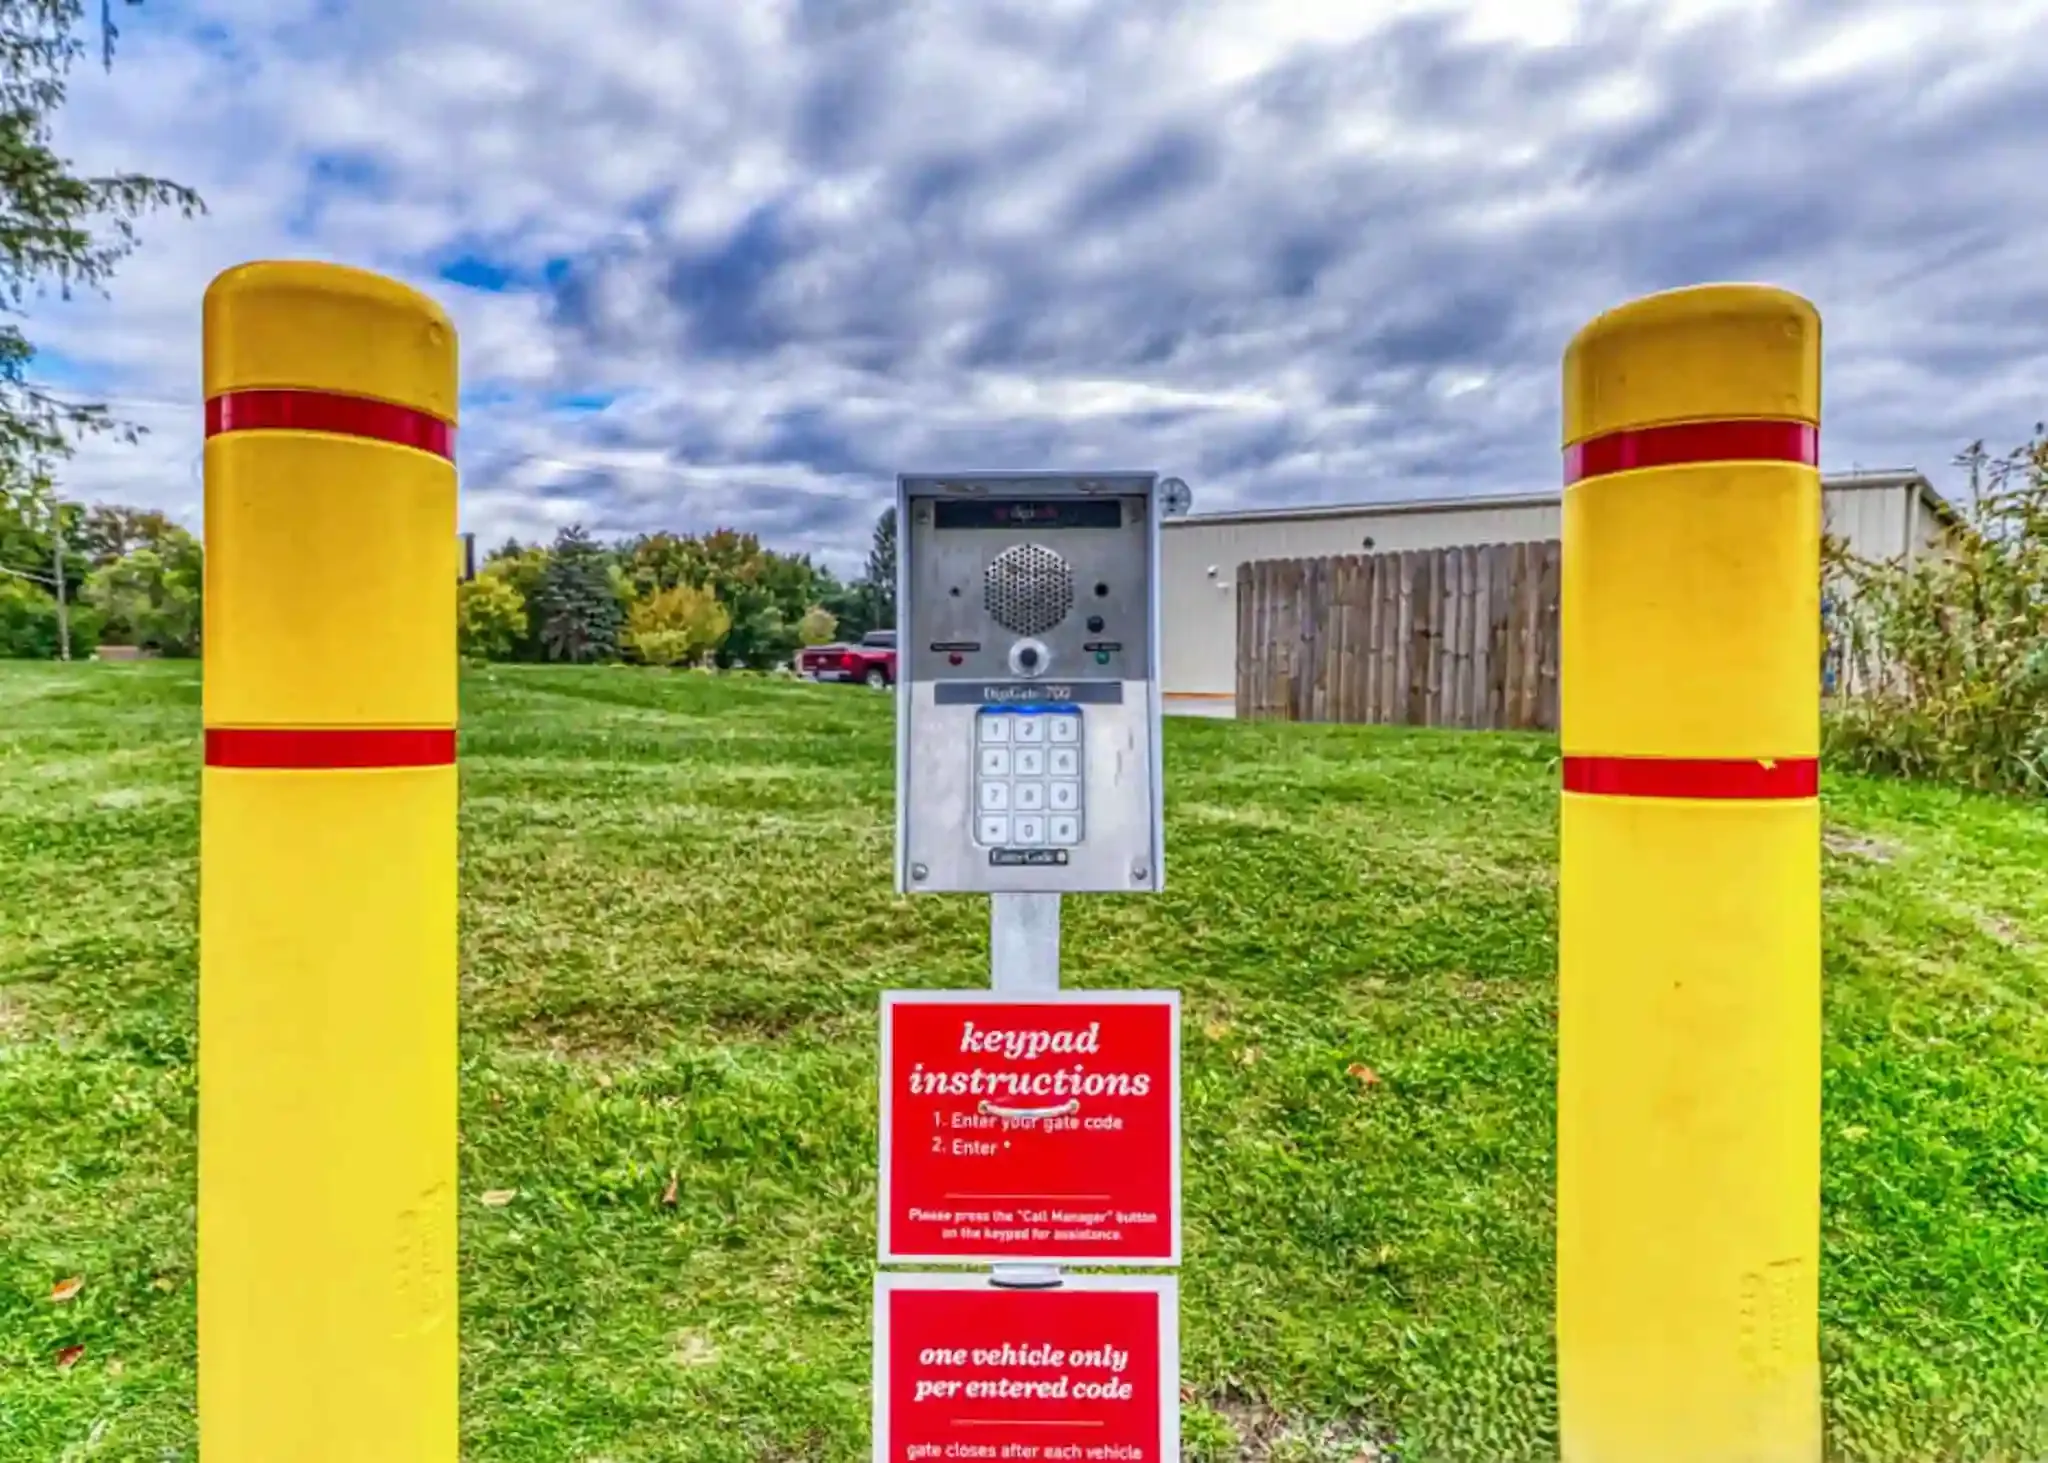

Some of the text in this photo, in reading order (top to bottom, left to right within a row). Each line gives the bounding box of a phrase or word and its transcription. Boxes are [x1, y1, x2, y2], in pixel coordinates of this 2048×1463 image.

[960, 1021, 1101, 1060] keypad
[908, 1062, 1151, 1097] instructions
[932, 1111, 1124, 1133] 1. Enter your gate code
[932, 1136, 947, 1154] 2.
[951, 1138, 998, 1156] Enter
[908, 1208, 951, 1222] Please
[955, 1211, 990, 1224] press
[993, 1209, 1014, 1223] the
[1115, 1210, 1158, 1224] button
[941, 1229, 957, 1240] on
[960, 1227, 981, 1240] the
[984, 1227, 1030, 1243] keypad
[1031, 1227, 1051, 1241] for
[919, 1342, 1129, 1373] one vehicle only
[913, 1376, 1134, 1402] per entered code
[906, 1442, 1144, 1461] gate closes after each vehicle
